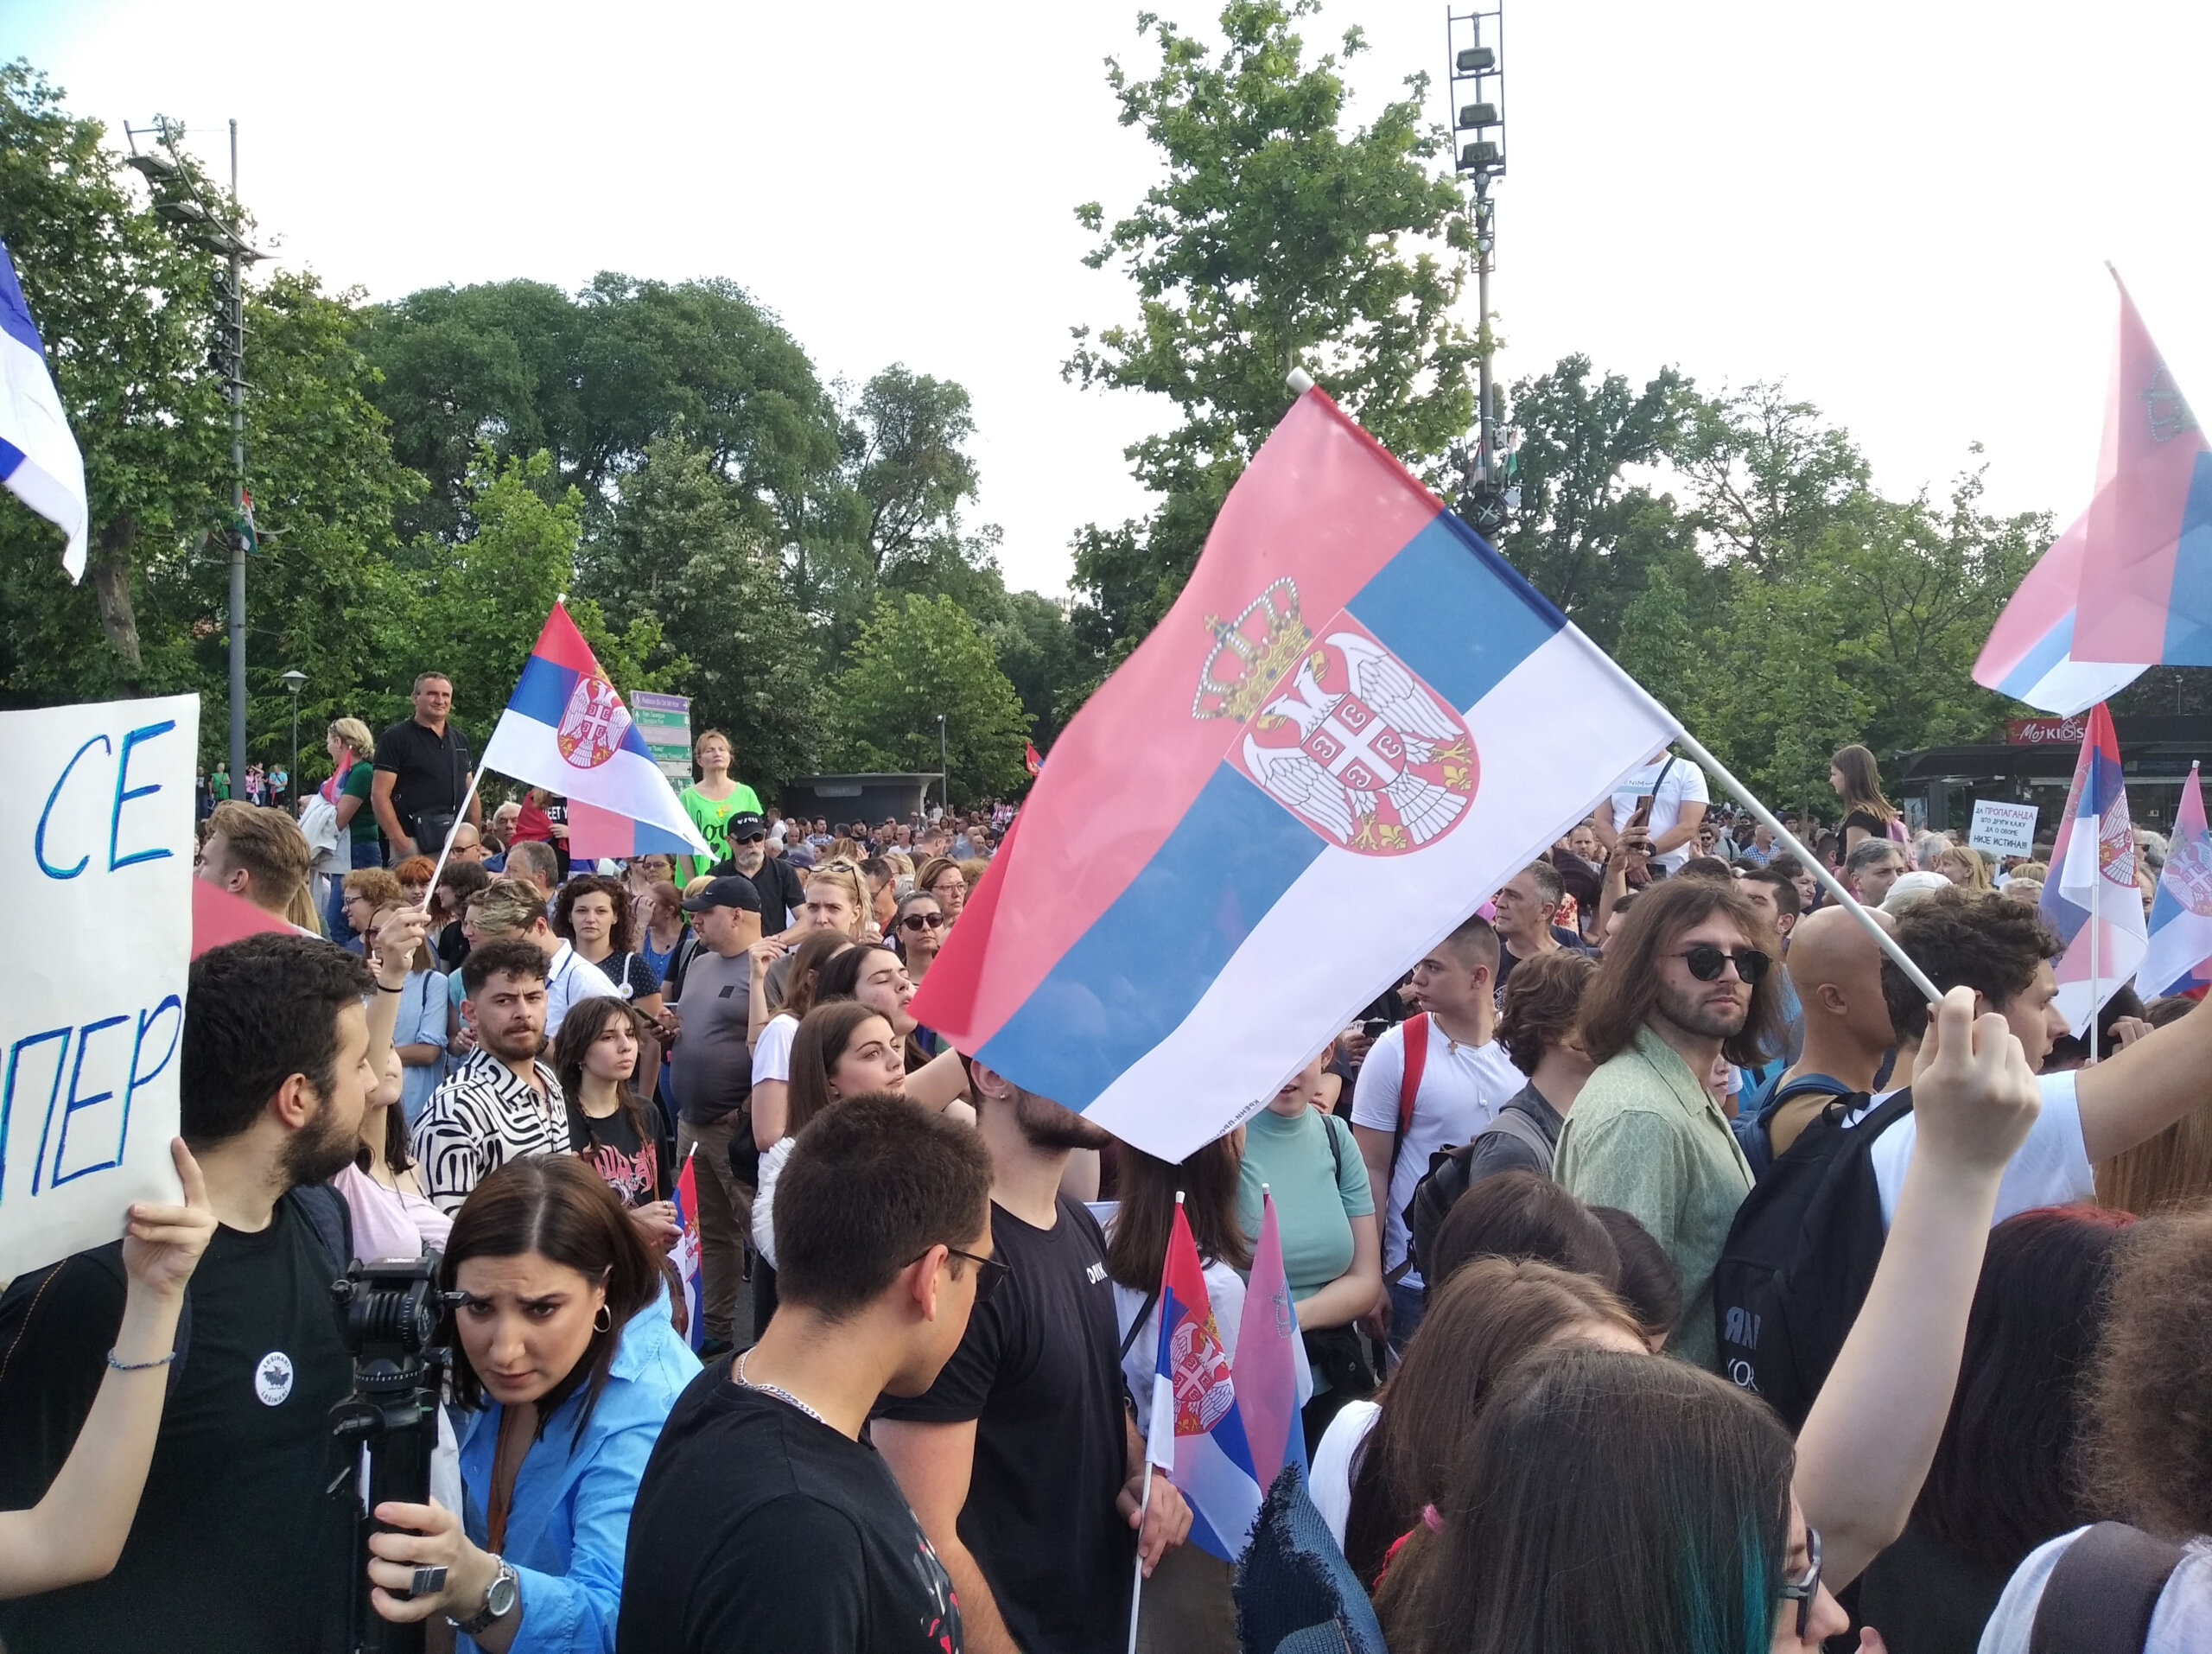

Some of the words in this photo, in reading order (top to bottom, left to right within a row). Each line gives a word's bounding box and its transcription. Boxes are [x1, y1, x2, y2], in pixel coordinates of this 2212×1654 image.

[2019, 722, 2045, 742] Moj
[2046, 718, 2088, 741] KIOS
[35, 721, 176, 880] СЕ
[1985, 807, 2034, 820] ПРОПАГАНДА
[2010, 820, 2026, 829] КАЖУ
[2000, 828, 2019, 837] ОВОМЕ
[1974, 835, 1992, 844] НИЈЕ
[1993, 837, 2028, 849] ИСТИНА!!!
[0, 995, 181, 1206] ПЕР
[264, 1354, 289, 1368] LEŠINARI
